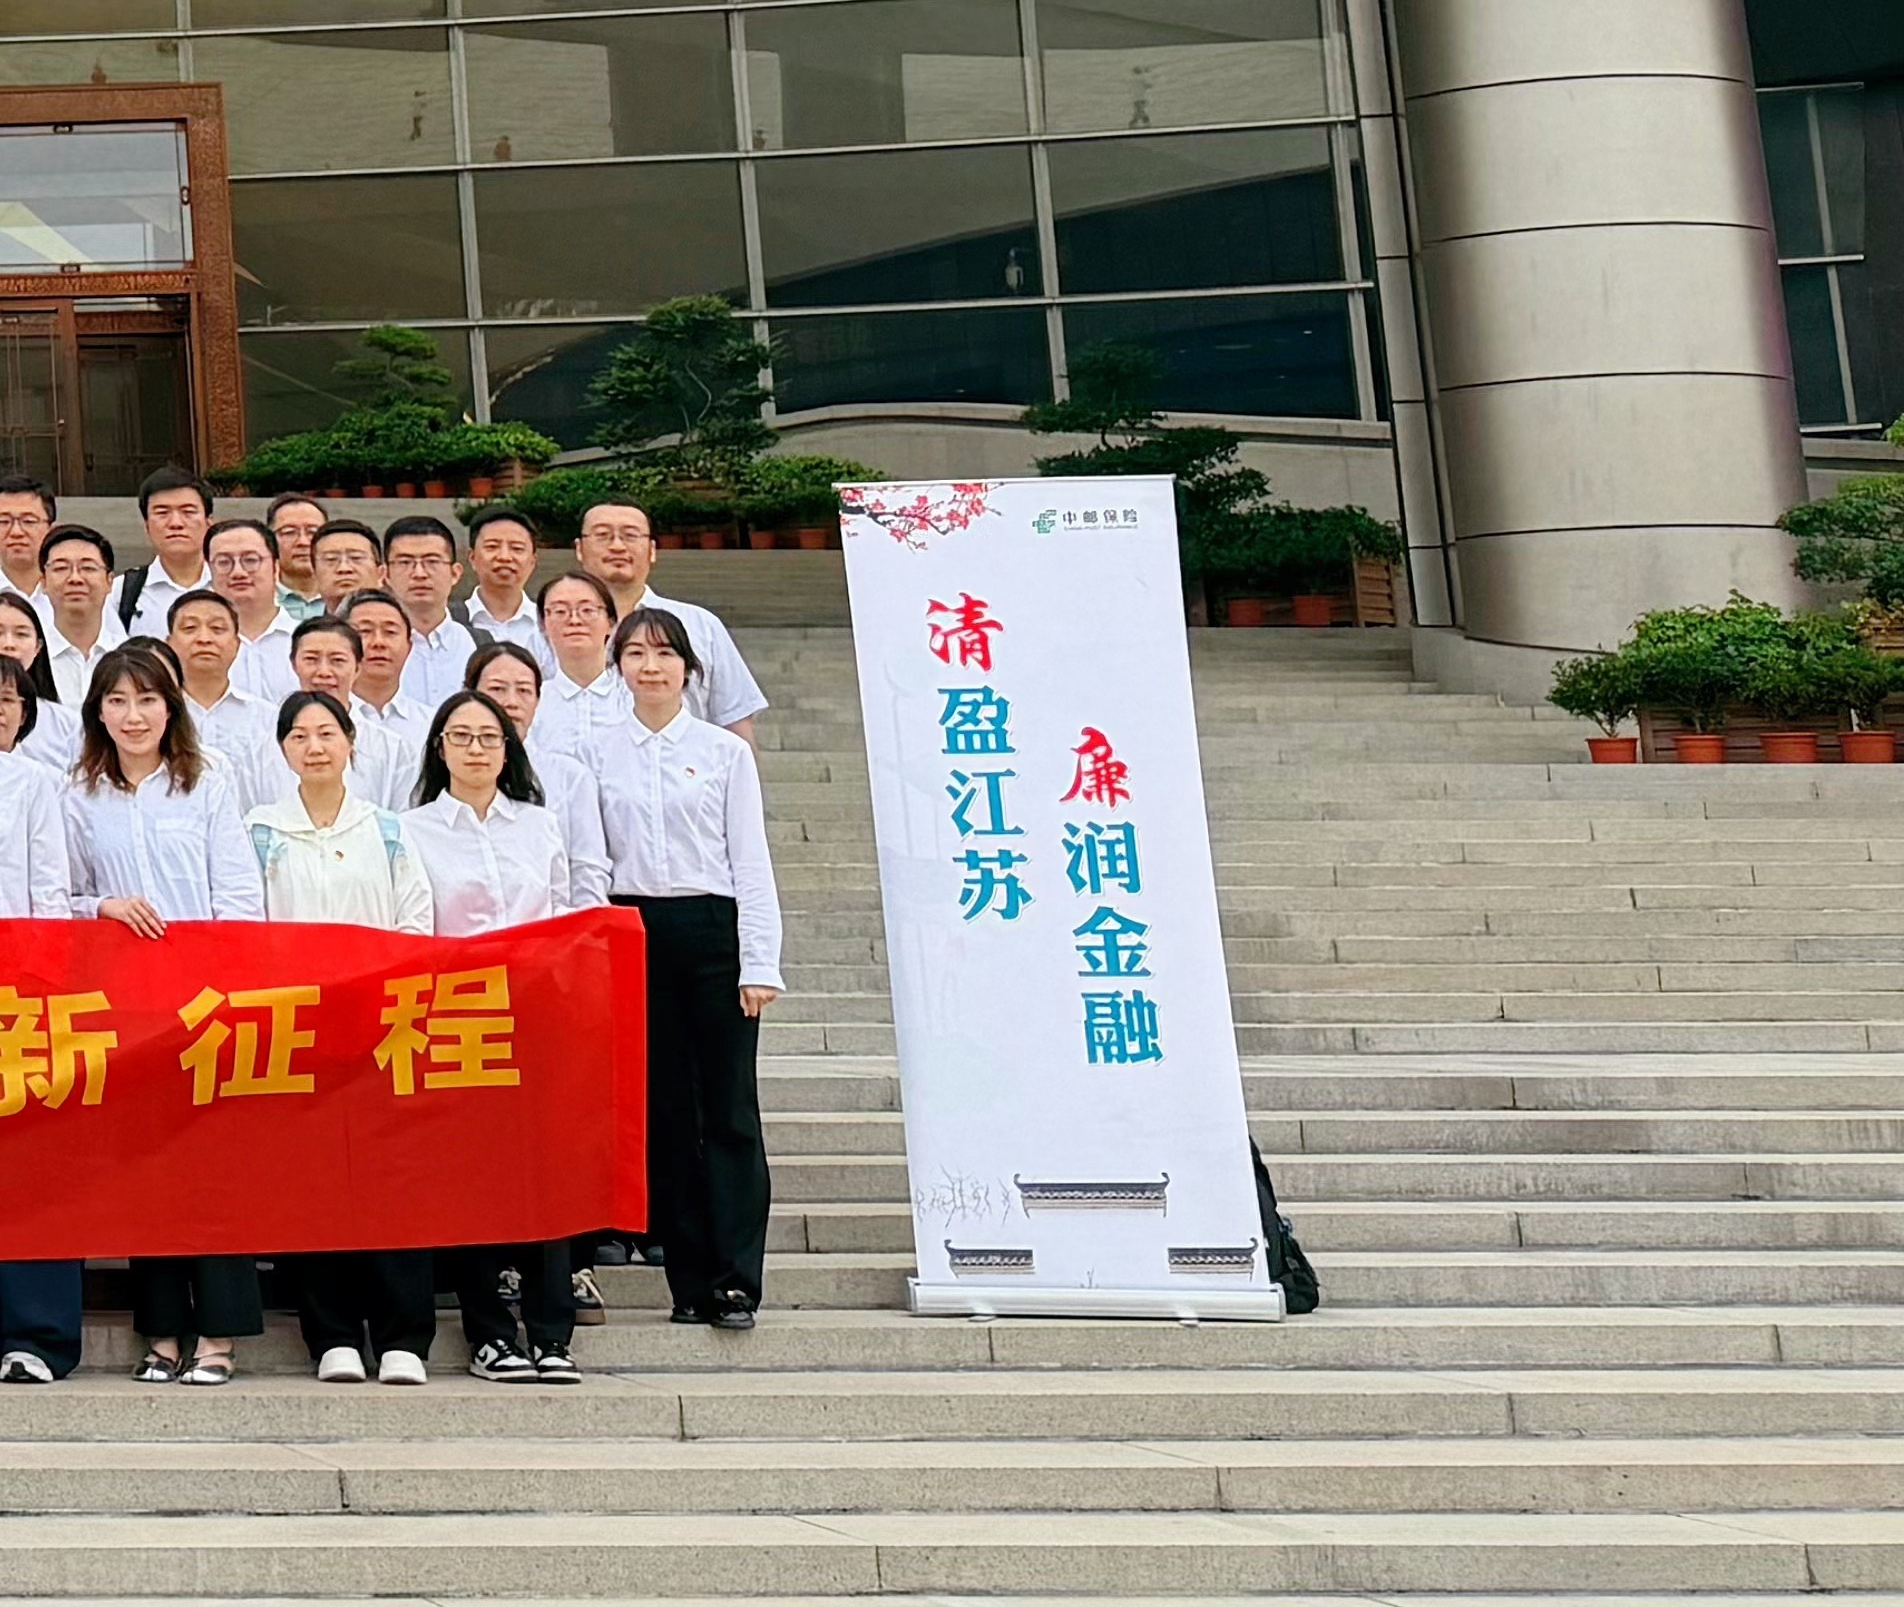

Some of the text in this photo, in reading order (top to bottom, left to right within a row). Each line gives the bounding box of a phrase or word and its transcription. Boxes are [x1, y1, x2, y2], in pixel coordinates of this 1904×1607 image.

[926, 593, 1034, 921] 清盈江苏
[1059, 726, 1165, 1065] 廉润金融
